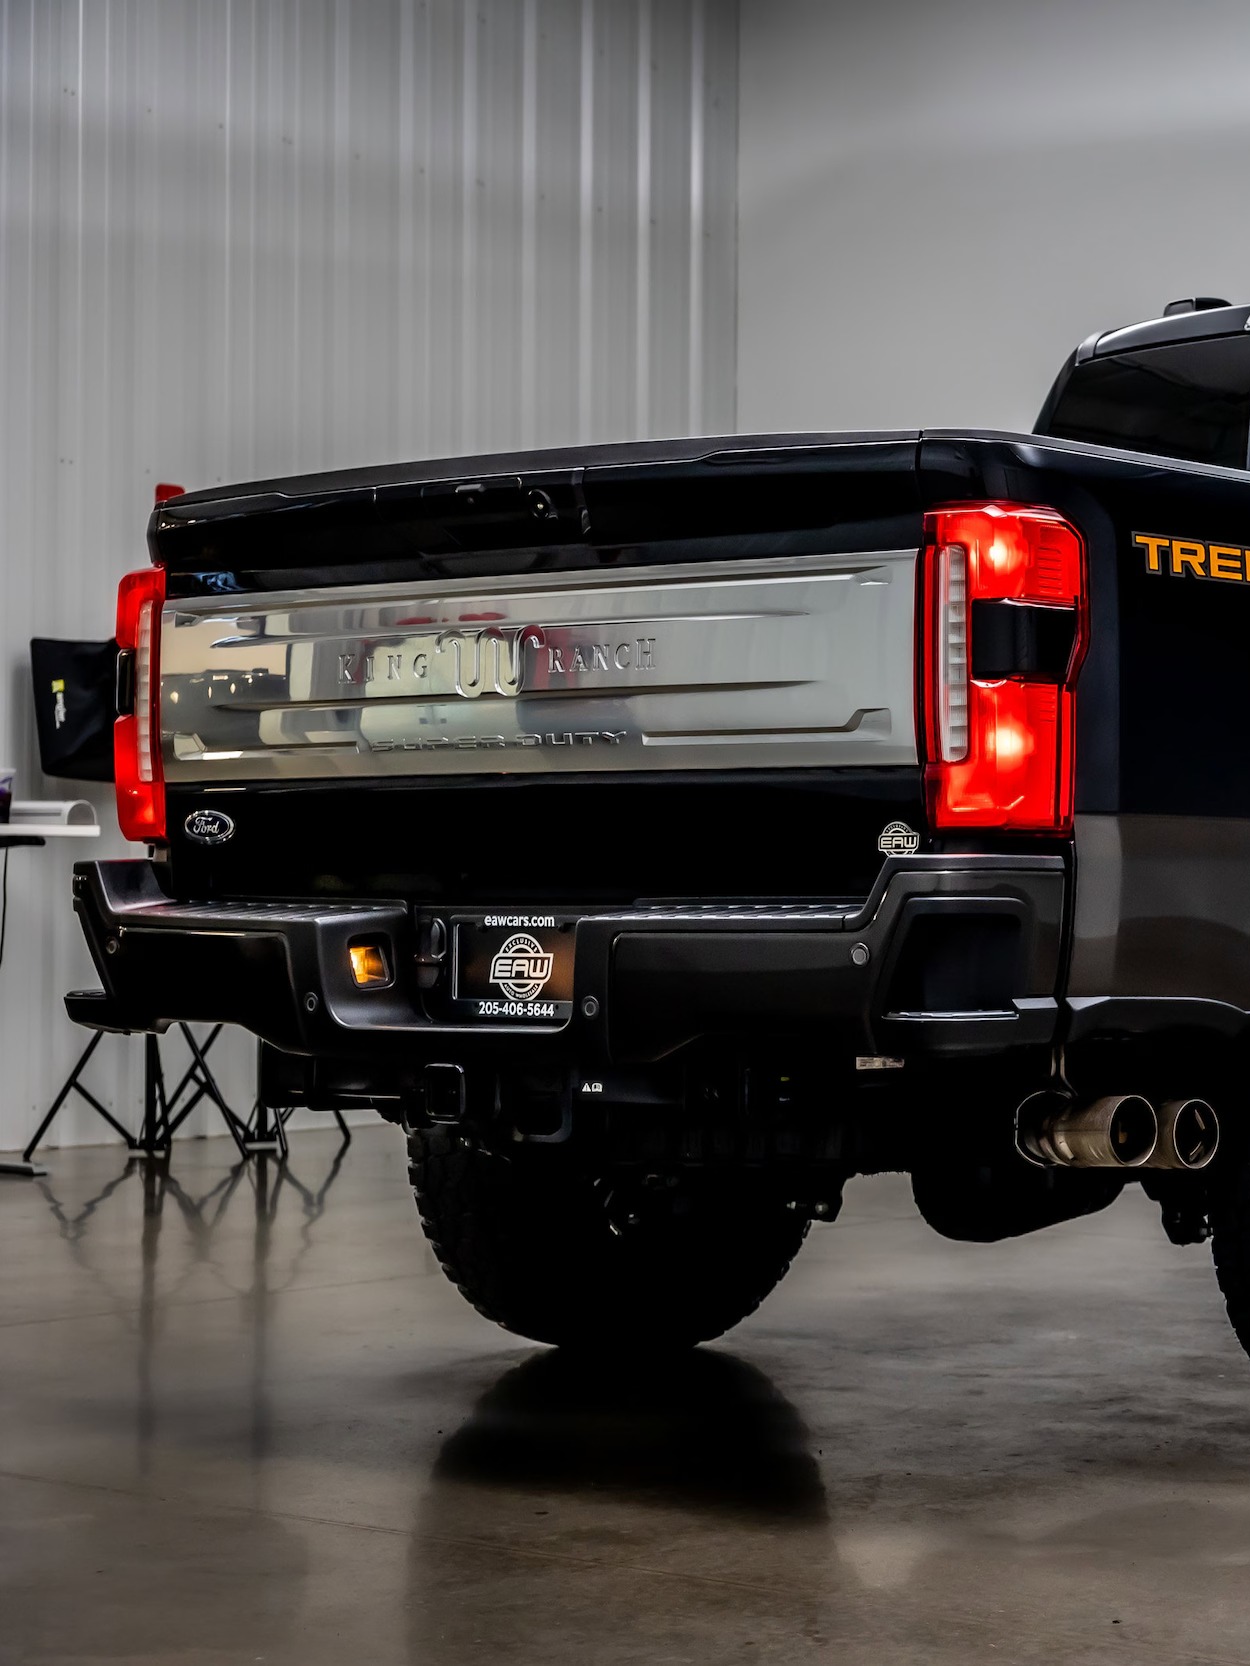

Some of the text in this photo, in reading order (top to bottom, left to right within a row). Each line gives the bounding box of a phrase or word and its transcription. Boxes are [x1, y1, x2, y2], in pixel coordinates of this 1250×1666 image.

[338, 638, 656, 684] KING RANCH
[371, 730, 627, 753] SUPER DUTY
[193, 816, 220, 834] Ford
[880, 836, 917, 849] EAW
[484, 915, 555, 927] eawcars.com
[494, 959, 549, 978] EAW
[478, 1001, 554, 1017] 205-406-5644
